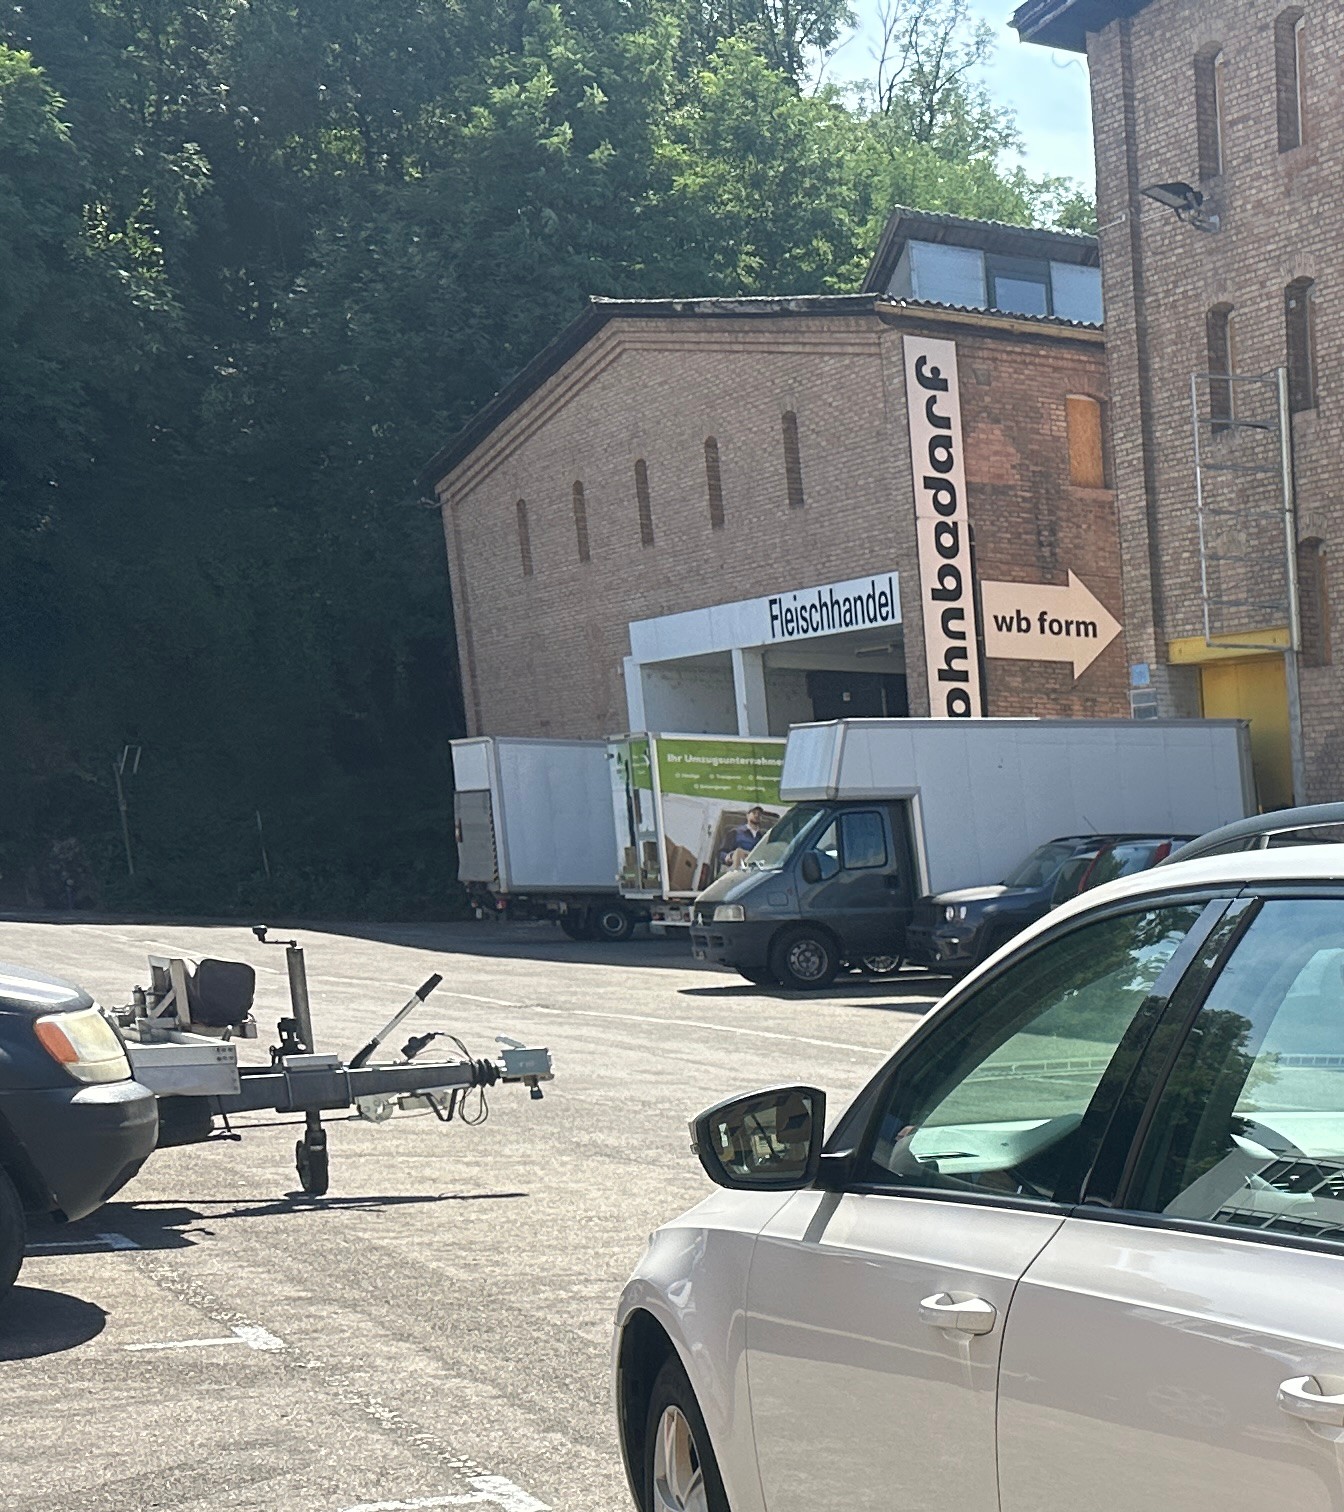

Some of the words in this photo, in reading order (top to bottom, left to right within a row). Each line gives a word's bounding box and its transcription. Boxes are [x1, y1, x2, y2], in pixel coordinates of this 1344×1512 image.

[914, 354, 972, 718] ohnbedarf
[768, 576, 896, 640] Fleischhandel
[993, 609, 1032, 635] wb
[1038, 610, 1098, 639] form
[667, 753, 683, 763] Ihr
[684, 753, 784, 767] Umzugsunternehme
